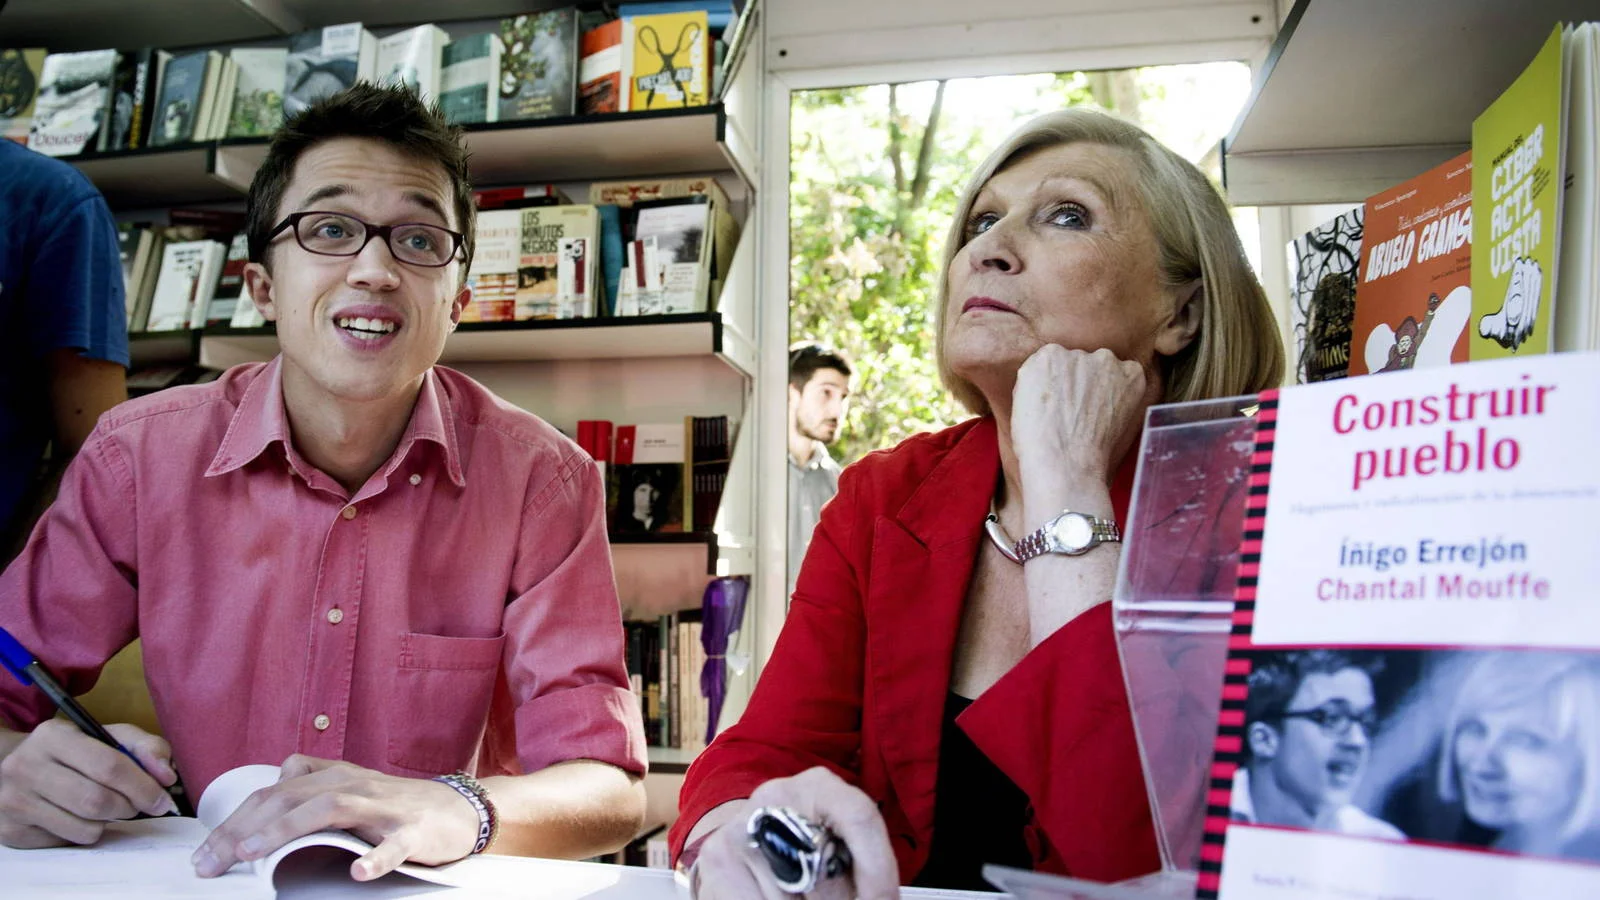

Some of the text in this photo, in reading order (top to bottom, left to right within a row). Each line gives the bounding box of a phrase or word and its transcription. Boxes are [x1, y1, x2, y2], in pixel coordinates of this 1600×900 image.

[1491, 123, 1544, 202] CIBER
[521, 211, 541, 226] LOS
[521, 224, 564, 240] MINUTOS
[1491, 174, 1535, 243] ACTI
[521, 241, 558, 255] NEGROS
[1364, 230, 1416, 283] ABUELO
[1417, 205, 1473, 264] GRAMSC
[1332, 374, 1557, 435] Construir
[1352, 427, 1522, 490] pueblo
[1338, 535, 1528, 572] Íñigo Errejón
[1316, 574, 1551, 602] Chantal Mouffe
[447, 781, 491, 854] ODEMOS
